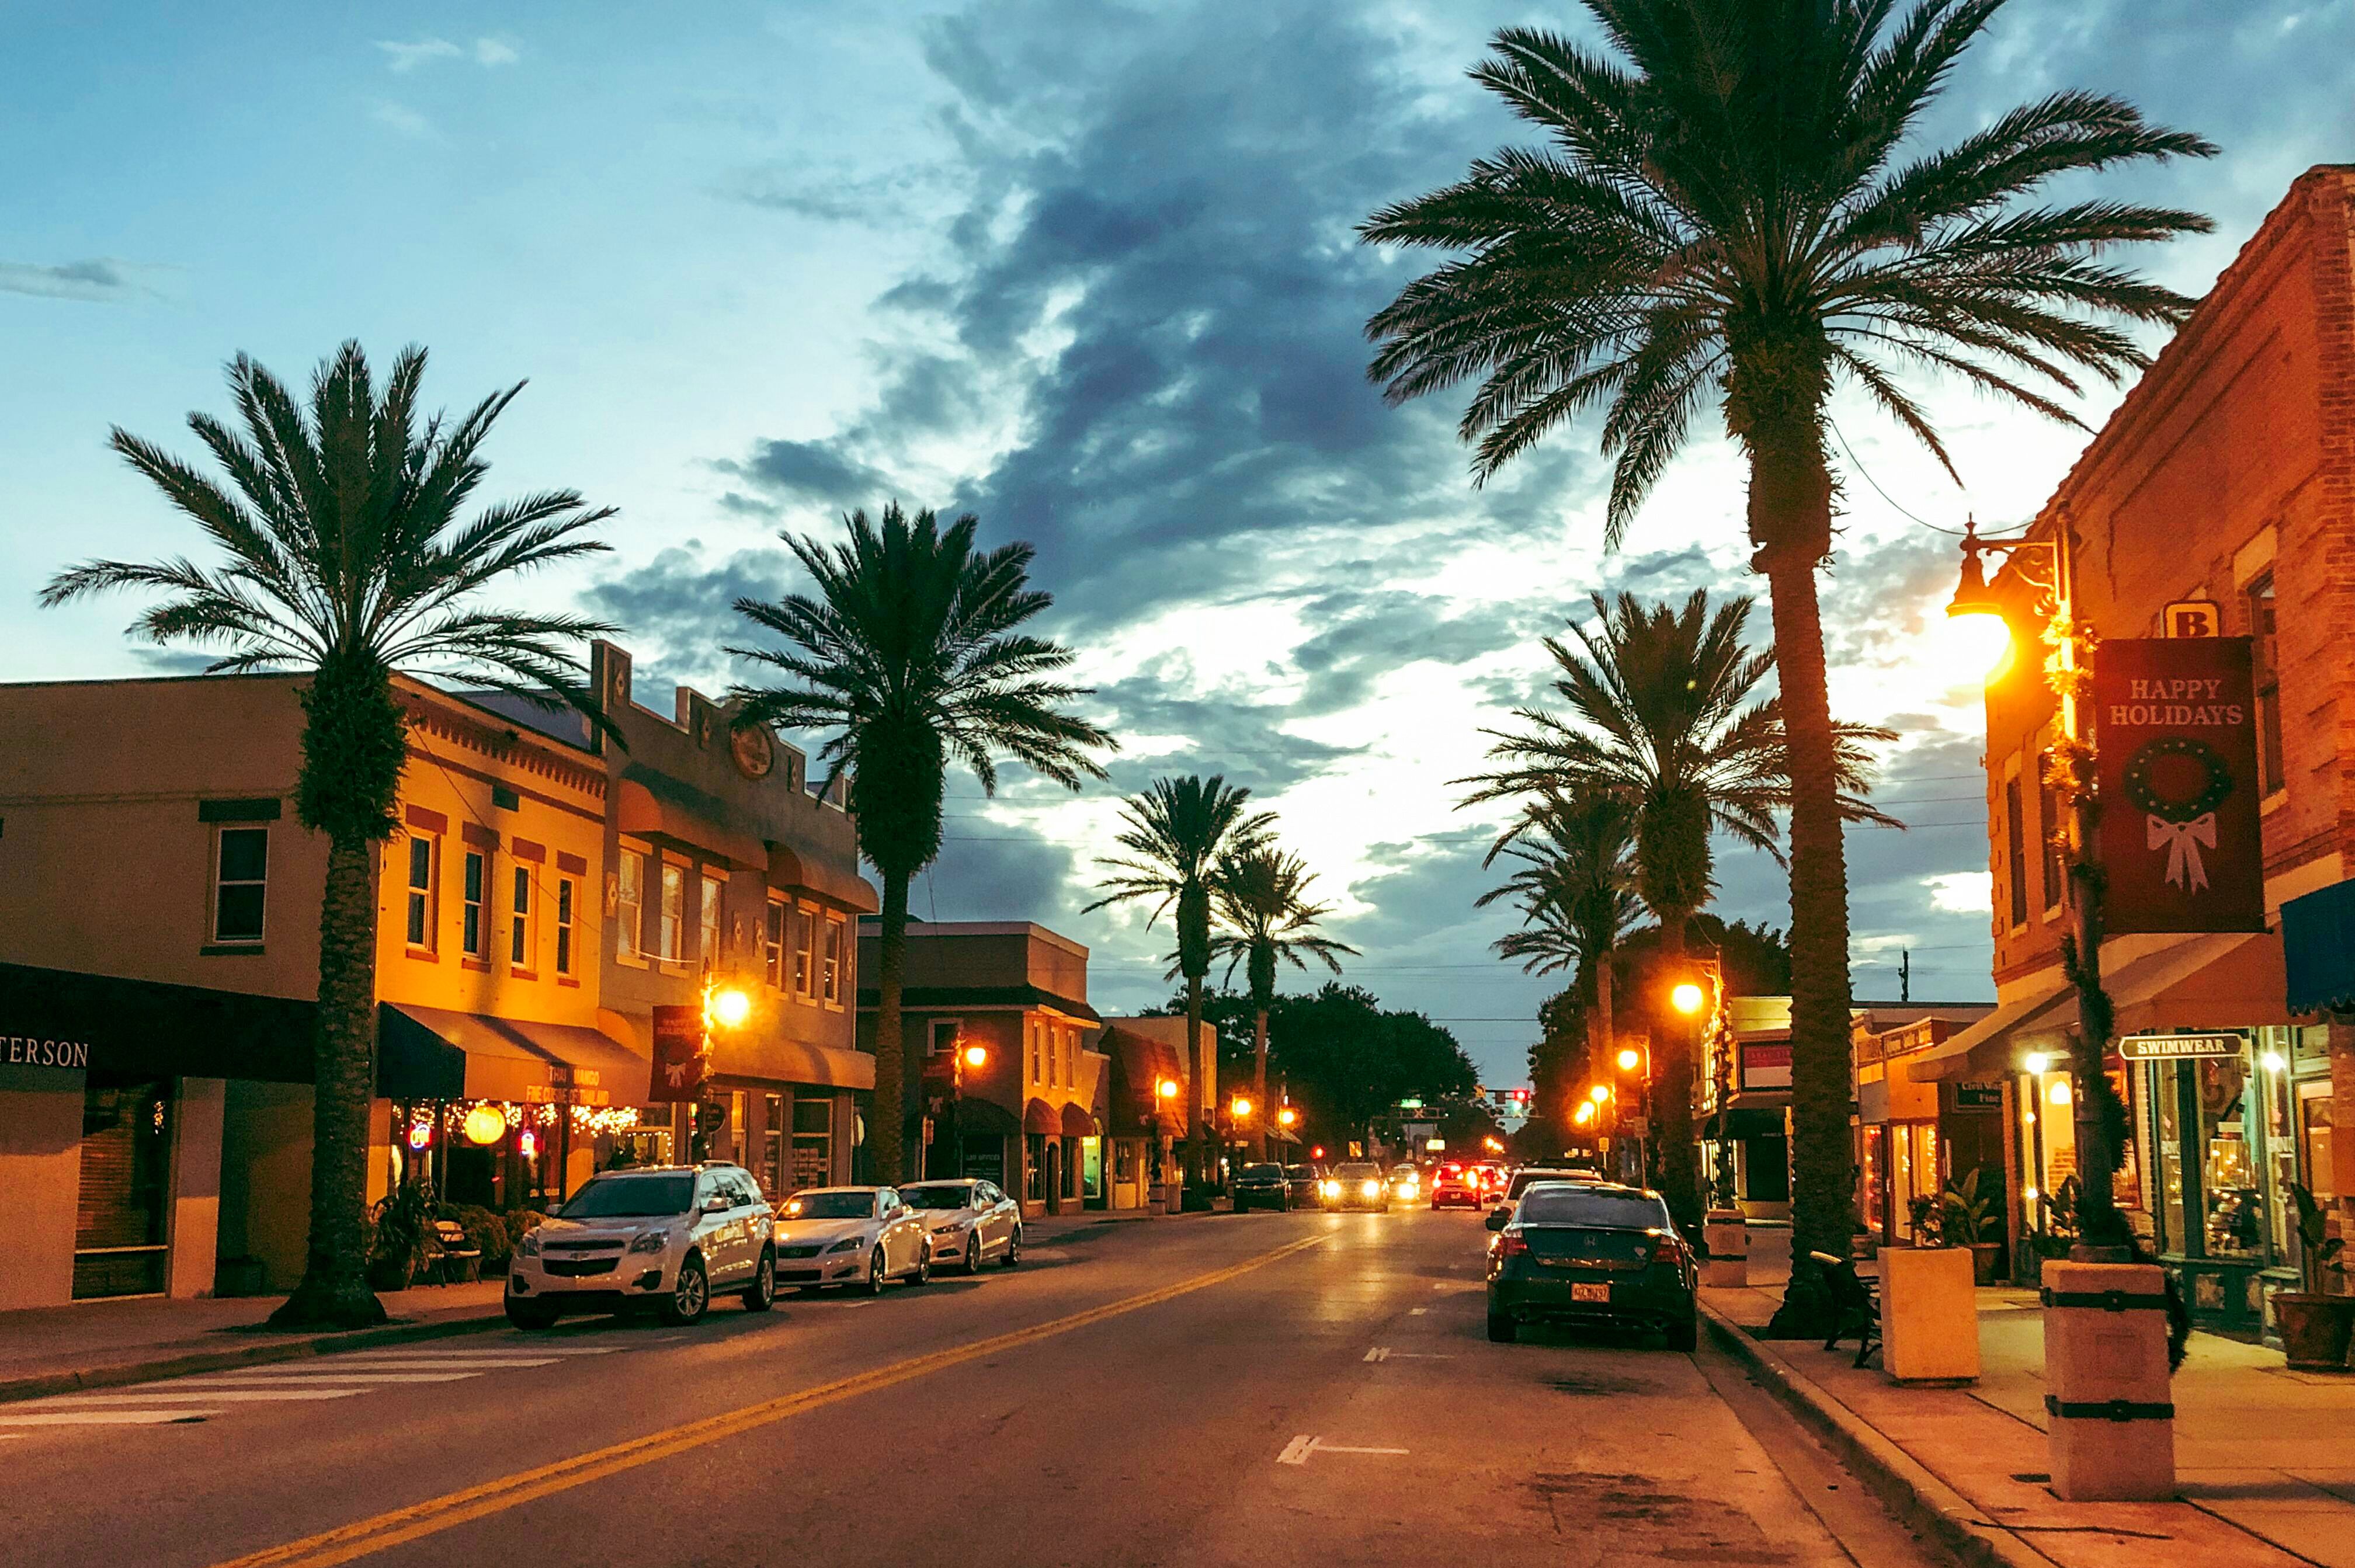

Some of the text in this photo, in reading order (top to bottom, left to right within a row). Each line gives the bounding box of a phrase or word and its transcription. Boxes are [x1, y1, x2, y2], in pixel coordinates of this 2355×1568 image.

[2176, 612, 2209, 637] B
[2131, 679, 2221, 700] HAPPY
[2110, 704, 2243, 725] HOLIDAYS
[2137, 1039, 2226, 1054] SWIMWEAR
[574, 1068, 600, 1086] MANGO
